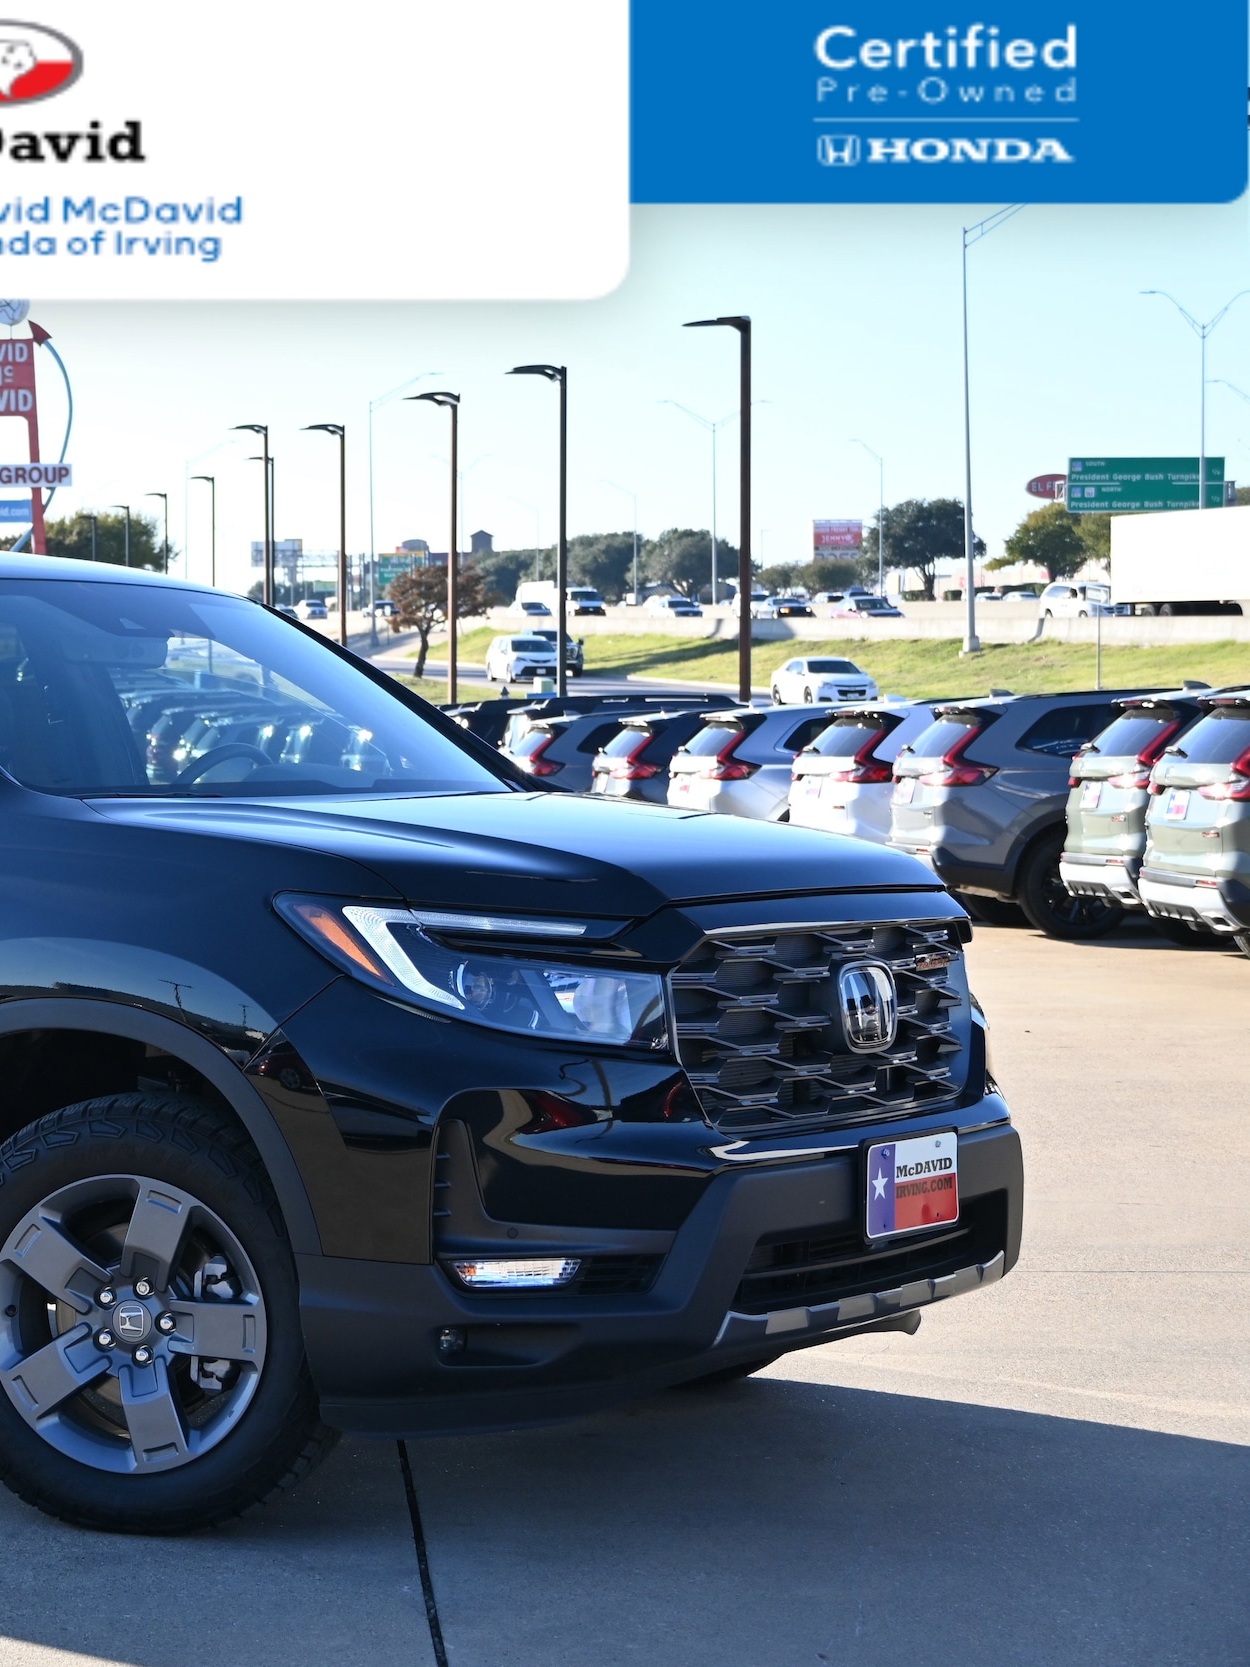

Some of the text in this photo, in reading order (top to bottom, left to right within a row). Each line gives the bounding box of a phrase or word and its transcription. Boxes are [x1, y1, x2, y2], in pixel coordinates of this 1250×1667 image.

[1071, 473, 1109, 481] President
[1112, 473, 1141, 482] George
[1112, 501, 1141, 509] George
[896, 1157, 953, 1178] McDAVID
[896, 1177, 953, 1199] IRVING.COM
